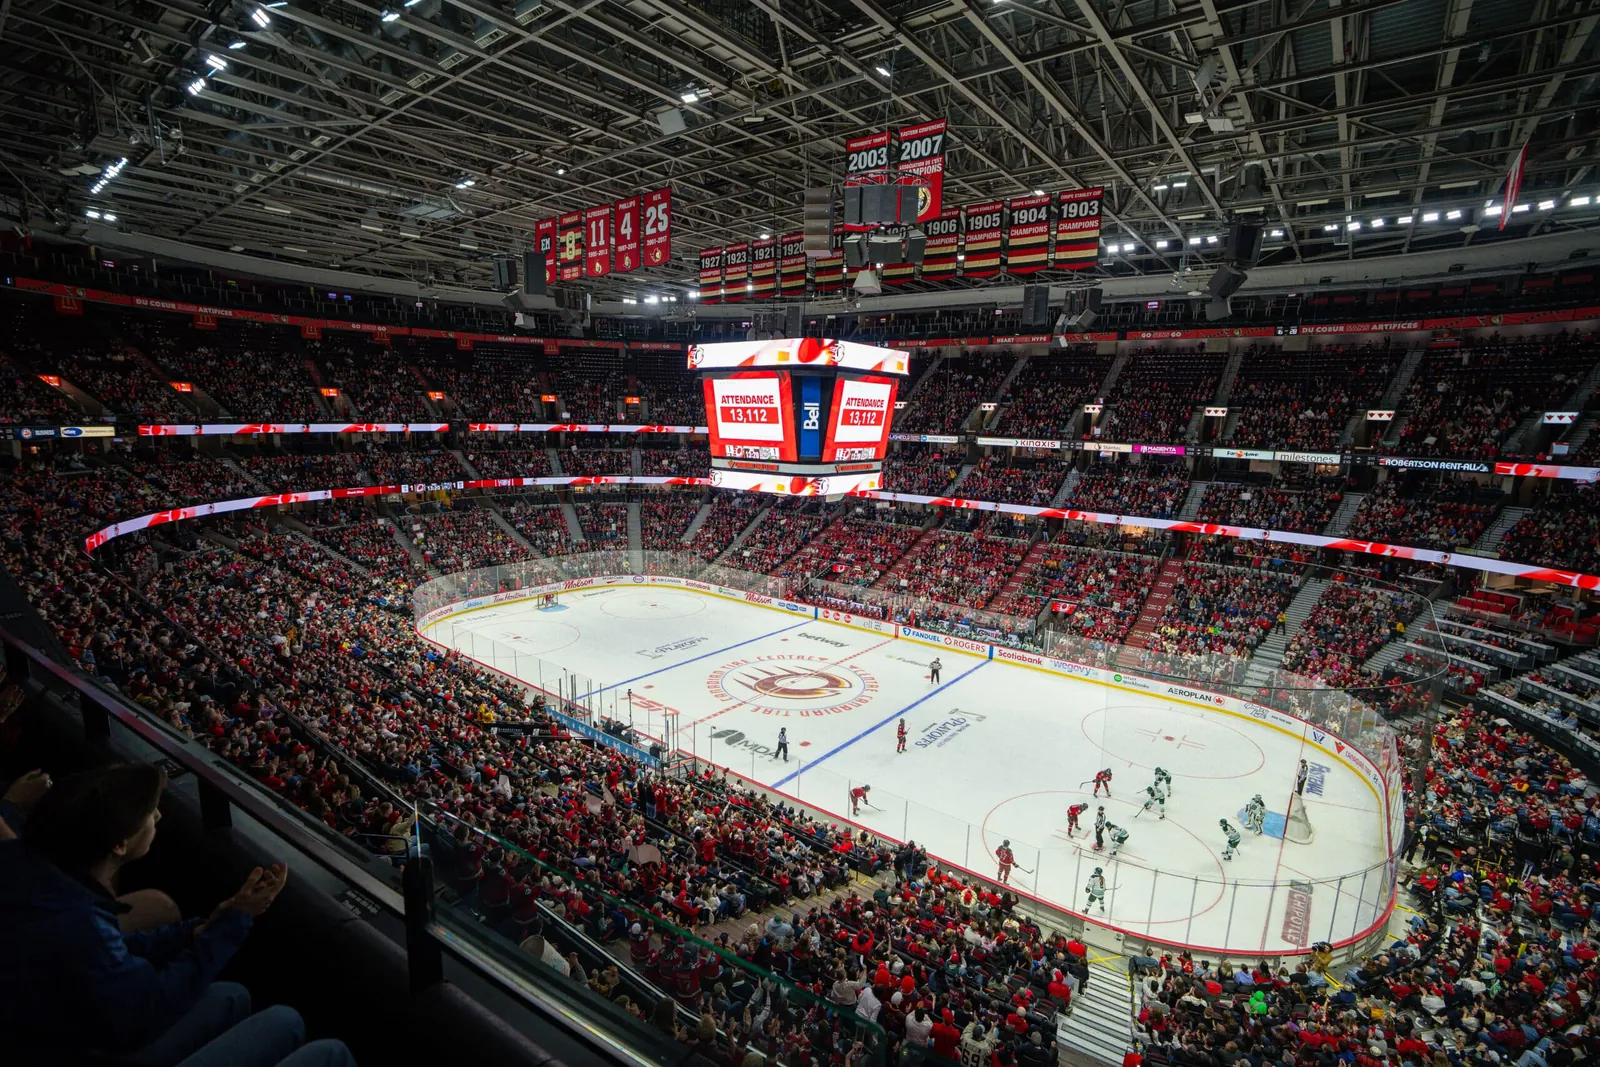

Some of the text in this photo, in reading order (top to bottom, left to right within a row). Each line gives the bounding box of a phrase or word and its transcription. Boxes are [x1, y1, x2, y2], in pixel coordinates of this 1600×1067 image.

[900, 134, 943, 160] 2007
[849, 147, 887, 171] 2003
[1012, 206, 1047, 225] 1904
[1061, 200, 1099, 219] 1903
[620, 212, 632, 240] 4
[646, 202, 668, 236] 25
[968, 213, 1000, 231] 1905
[1058, 220, 1099, 231] CHAMPIONS
[590, 219, 605, 247] 11
[927, 219, 957, 235] 1906
[1010, 225, 1048, 236] CHAMPIONS
[926, 236, 957, 246] CHAMPIONS
[966, 231, 1000, 242] CHAMPIONS
[541, 237, 551, 252] EM
[566, 231, 576, 260] 8
[783, 242, 804, 256] 1920
[726, 252, 747, 265] 1923
[754, 247, 775, 260] 1921
[701, 256, 720, 269] 1927
[198, 307, 233, 316] ARTIFICES
[1371, 322, 1418, 331] ARTIFICES
[722, 395, 774, 404] ATTENDANCE
[846, 398, 884, 408] ATTENDANCE
[730, 408, 767, 423] 13,112
[804, 402, 819, 430] Bell
[850, 411, 876, 425] 13,112
[1280, 453, 1334, 464] milestones
[1386, 458, 1478, 471] ROBERTSON RENT-ALL
[563, 579, 594, 590] Molson
[685, 580, 711, 591] Scotiabank
[504, 592, 527, 602] Hortons
[744, 592, 772, 604] Molson
[428, 606, 453, 621] Scotiabank
[798, 632, 850, 648] betway
[912, 631, 941, 642] FANDUEL
[953, 639, 986, 653] ROGERS
[998, 649, 1043, 666] Scotiabank
[1054, 660, 1091, 676] wegovy
[706, 670, 733, 702] CANADIAN
[720, 659, 750, 670] TIRE
[1168, 687, 1212, 702] AEROPLAN
[750, 706, 791, 717] TIRE
[799, 695, 873, 717] CANADIAN
[915, 716, 967, 748] PLAYOFFS
[1287, 894, 1306, 945] CHIPOTLE
